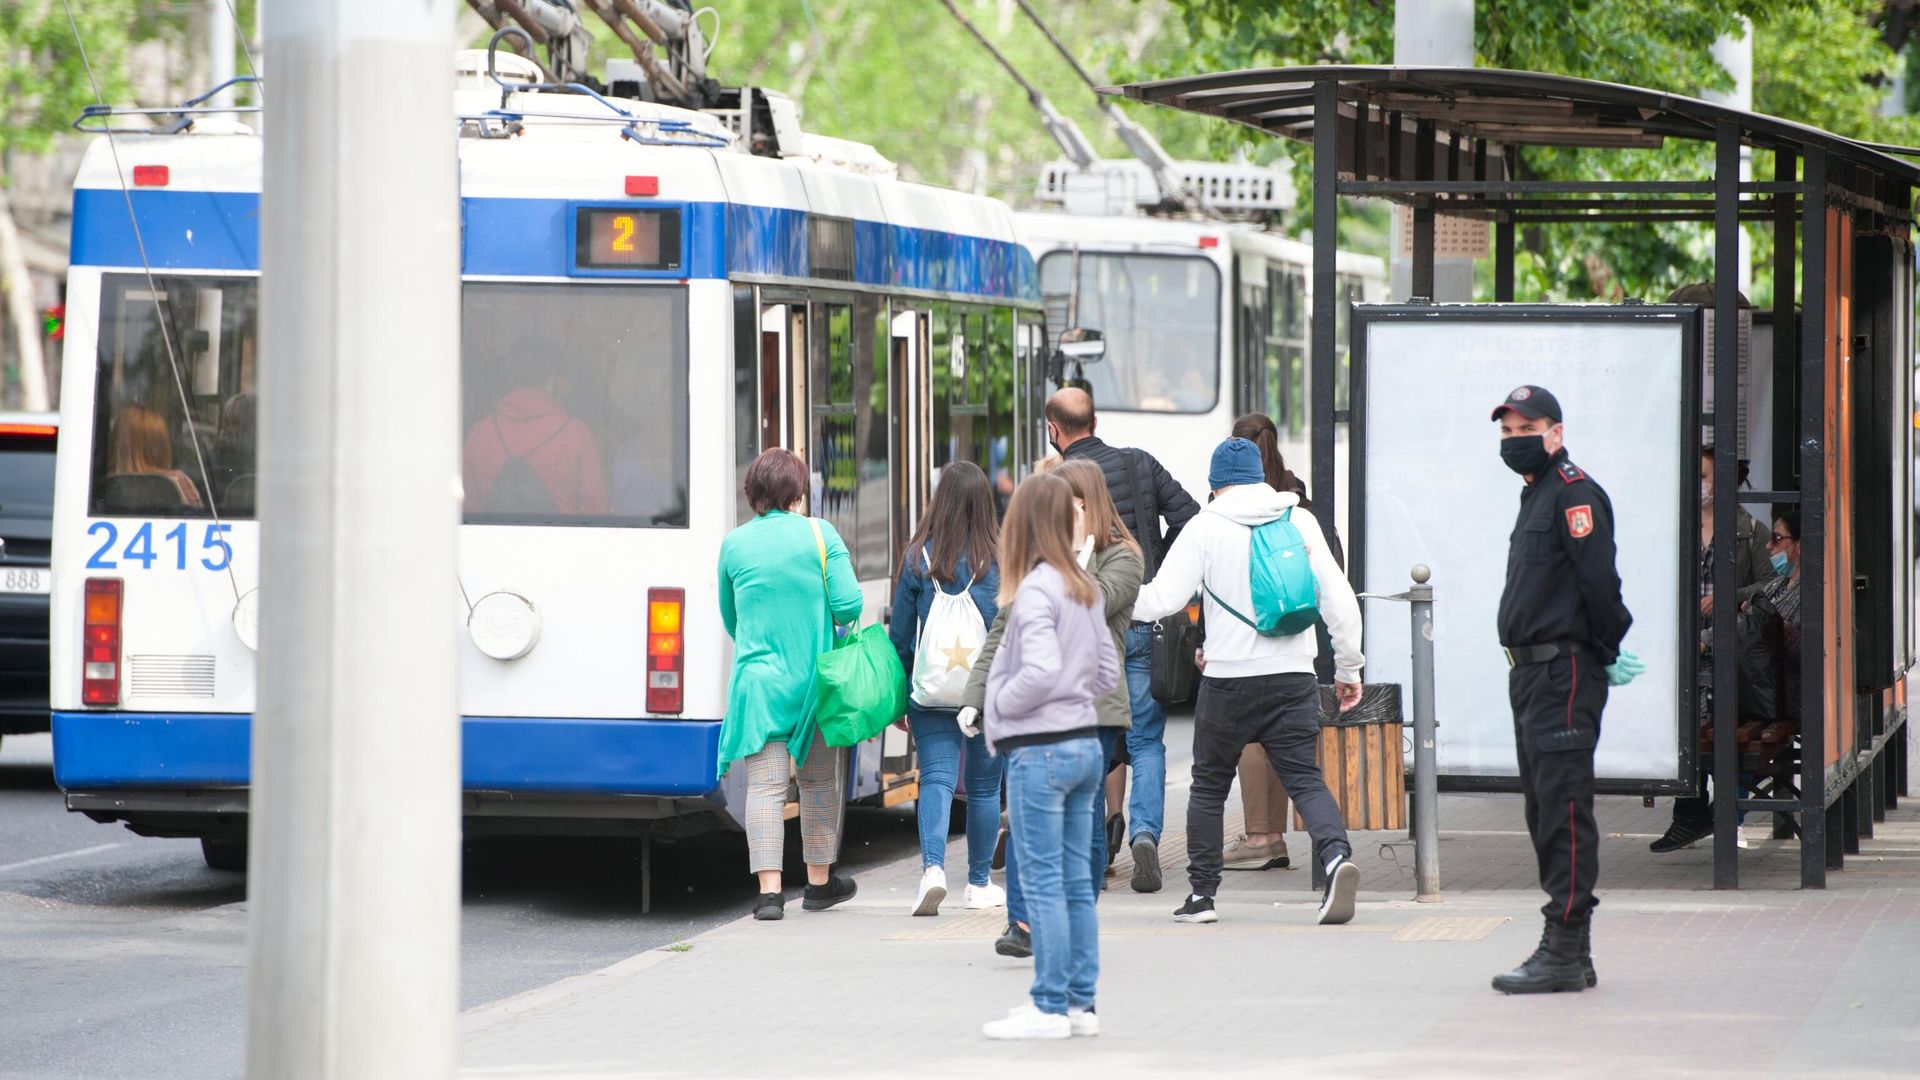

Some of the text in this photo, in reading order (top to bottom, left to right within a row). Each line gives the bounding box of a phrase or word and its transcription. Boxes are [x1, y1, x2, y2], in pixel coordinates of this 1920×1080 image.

[613, 215, 634, 251] 2
[85, 521, 233, 572] 2415
[6, 571, 40, 590] 888
